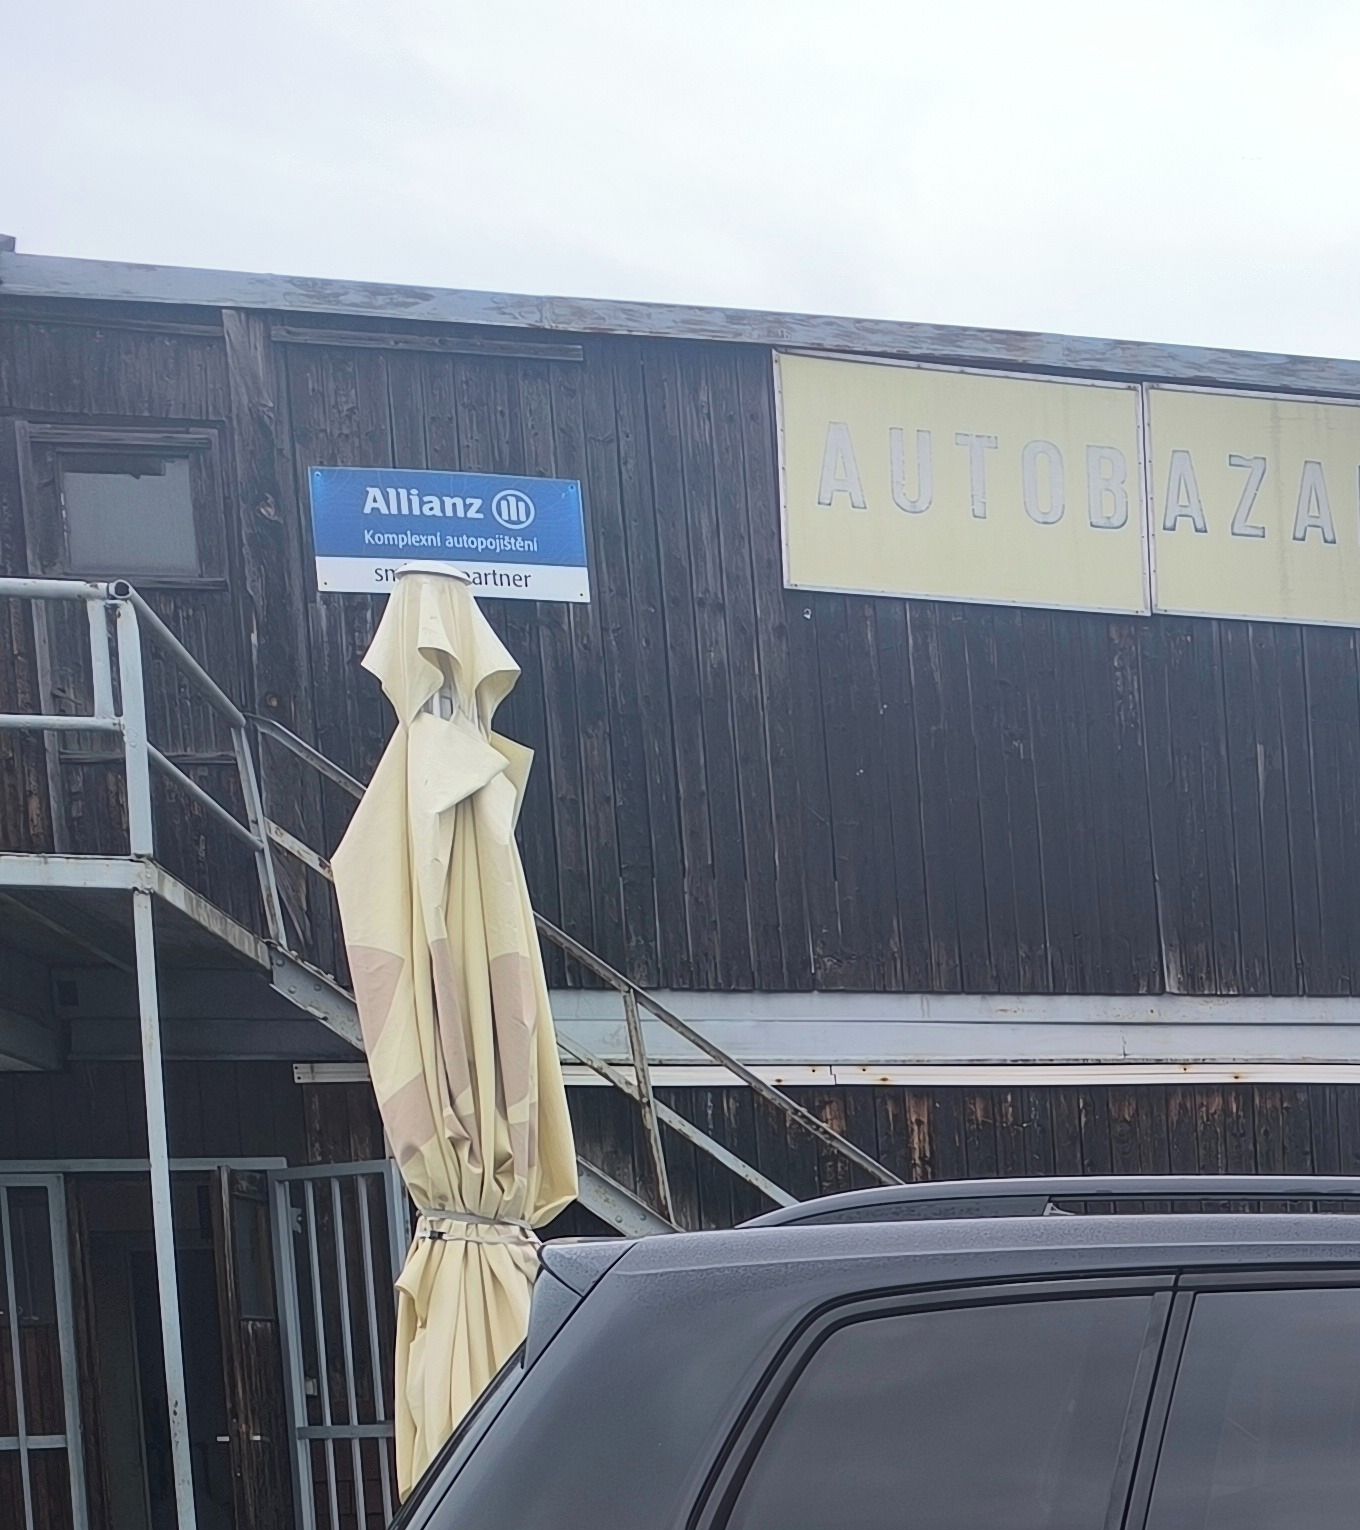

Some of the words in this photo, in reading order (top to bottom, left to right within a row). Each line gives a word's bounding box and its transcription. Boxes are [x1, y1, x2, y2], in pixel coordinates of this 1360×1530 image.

[363, 487, 485, 519] Allianz
[364, 530, 441, 548] Komplexní
[446, 532, 538, 553] autopojištění
